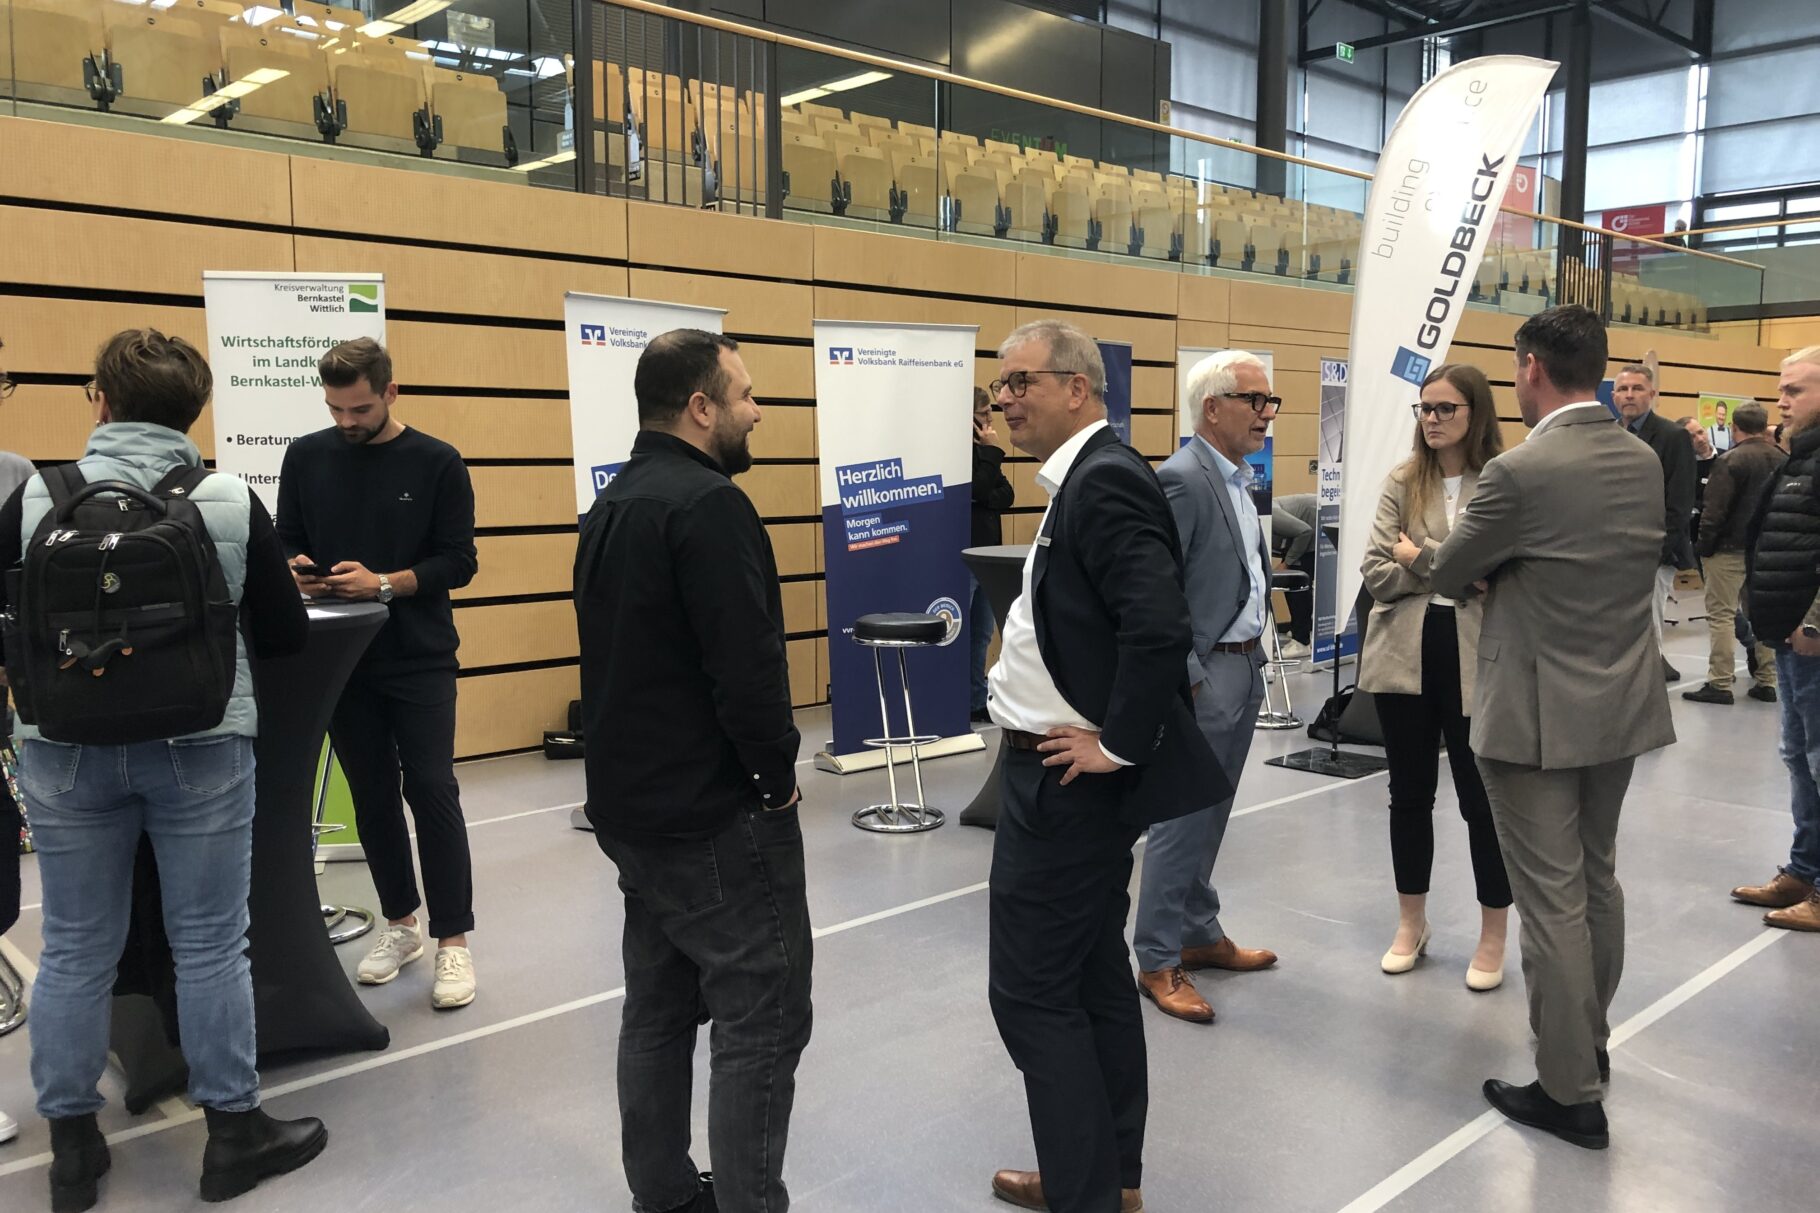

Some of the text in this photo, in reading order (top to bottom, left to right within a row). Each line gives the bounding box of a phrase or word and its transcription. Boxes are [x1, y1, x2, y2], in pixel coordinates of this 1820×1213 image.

[1371, 158, 1430, 259] building
[1417, 152, 1505, 350] GOLDBECK
[274, 283, 344, 294] Kreisverwaltung
[297, 294, 345, 303] Bernkastel
[310, 304, 345, 313] Wittlich
[609, 326, 648, 340] Vereinigte
[857, 348, 897, 357] Vereinigte
[253, 356, 271, 368] im
[858, 358, 964, 368] Volksbank Raiffeisenbank eG
[839, 461, 902, 486] Herzlich
[842, 482, 942, 509] willkommen.
[846, 516, 881, 529] Morgen
[848, 523, 908, 541] kann kommen.
